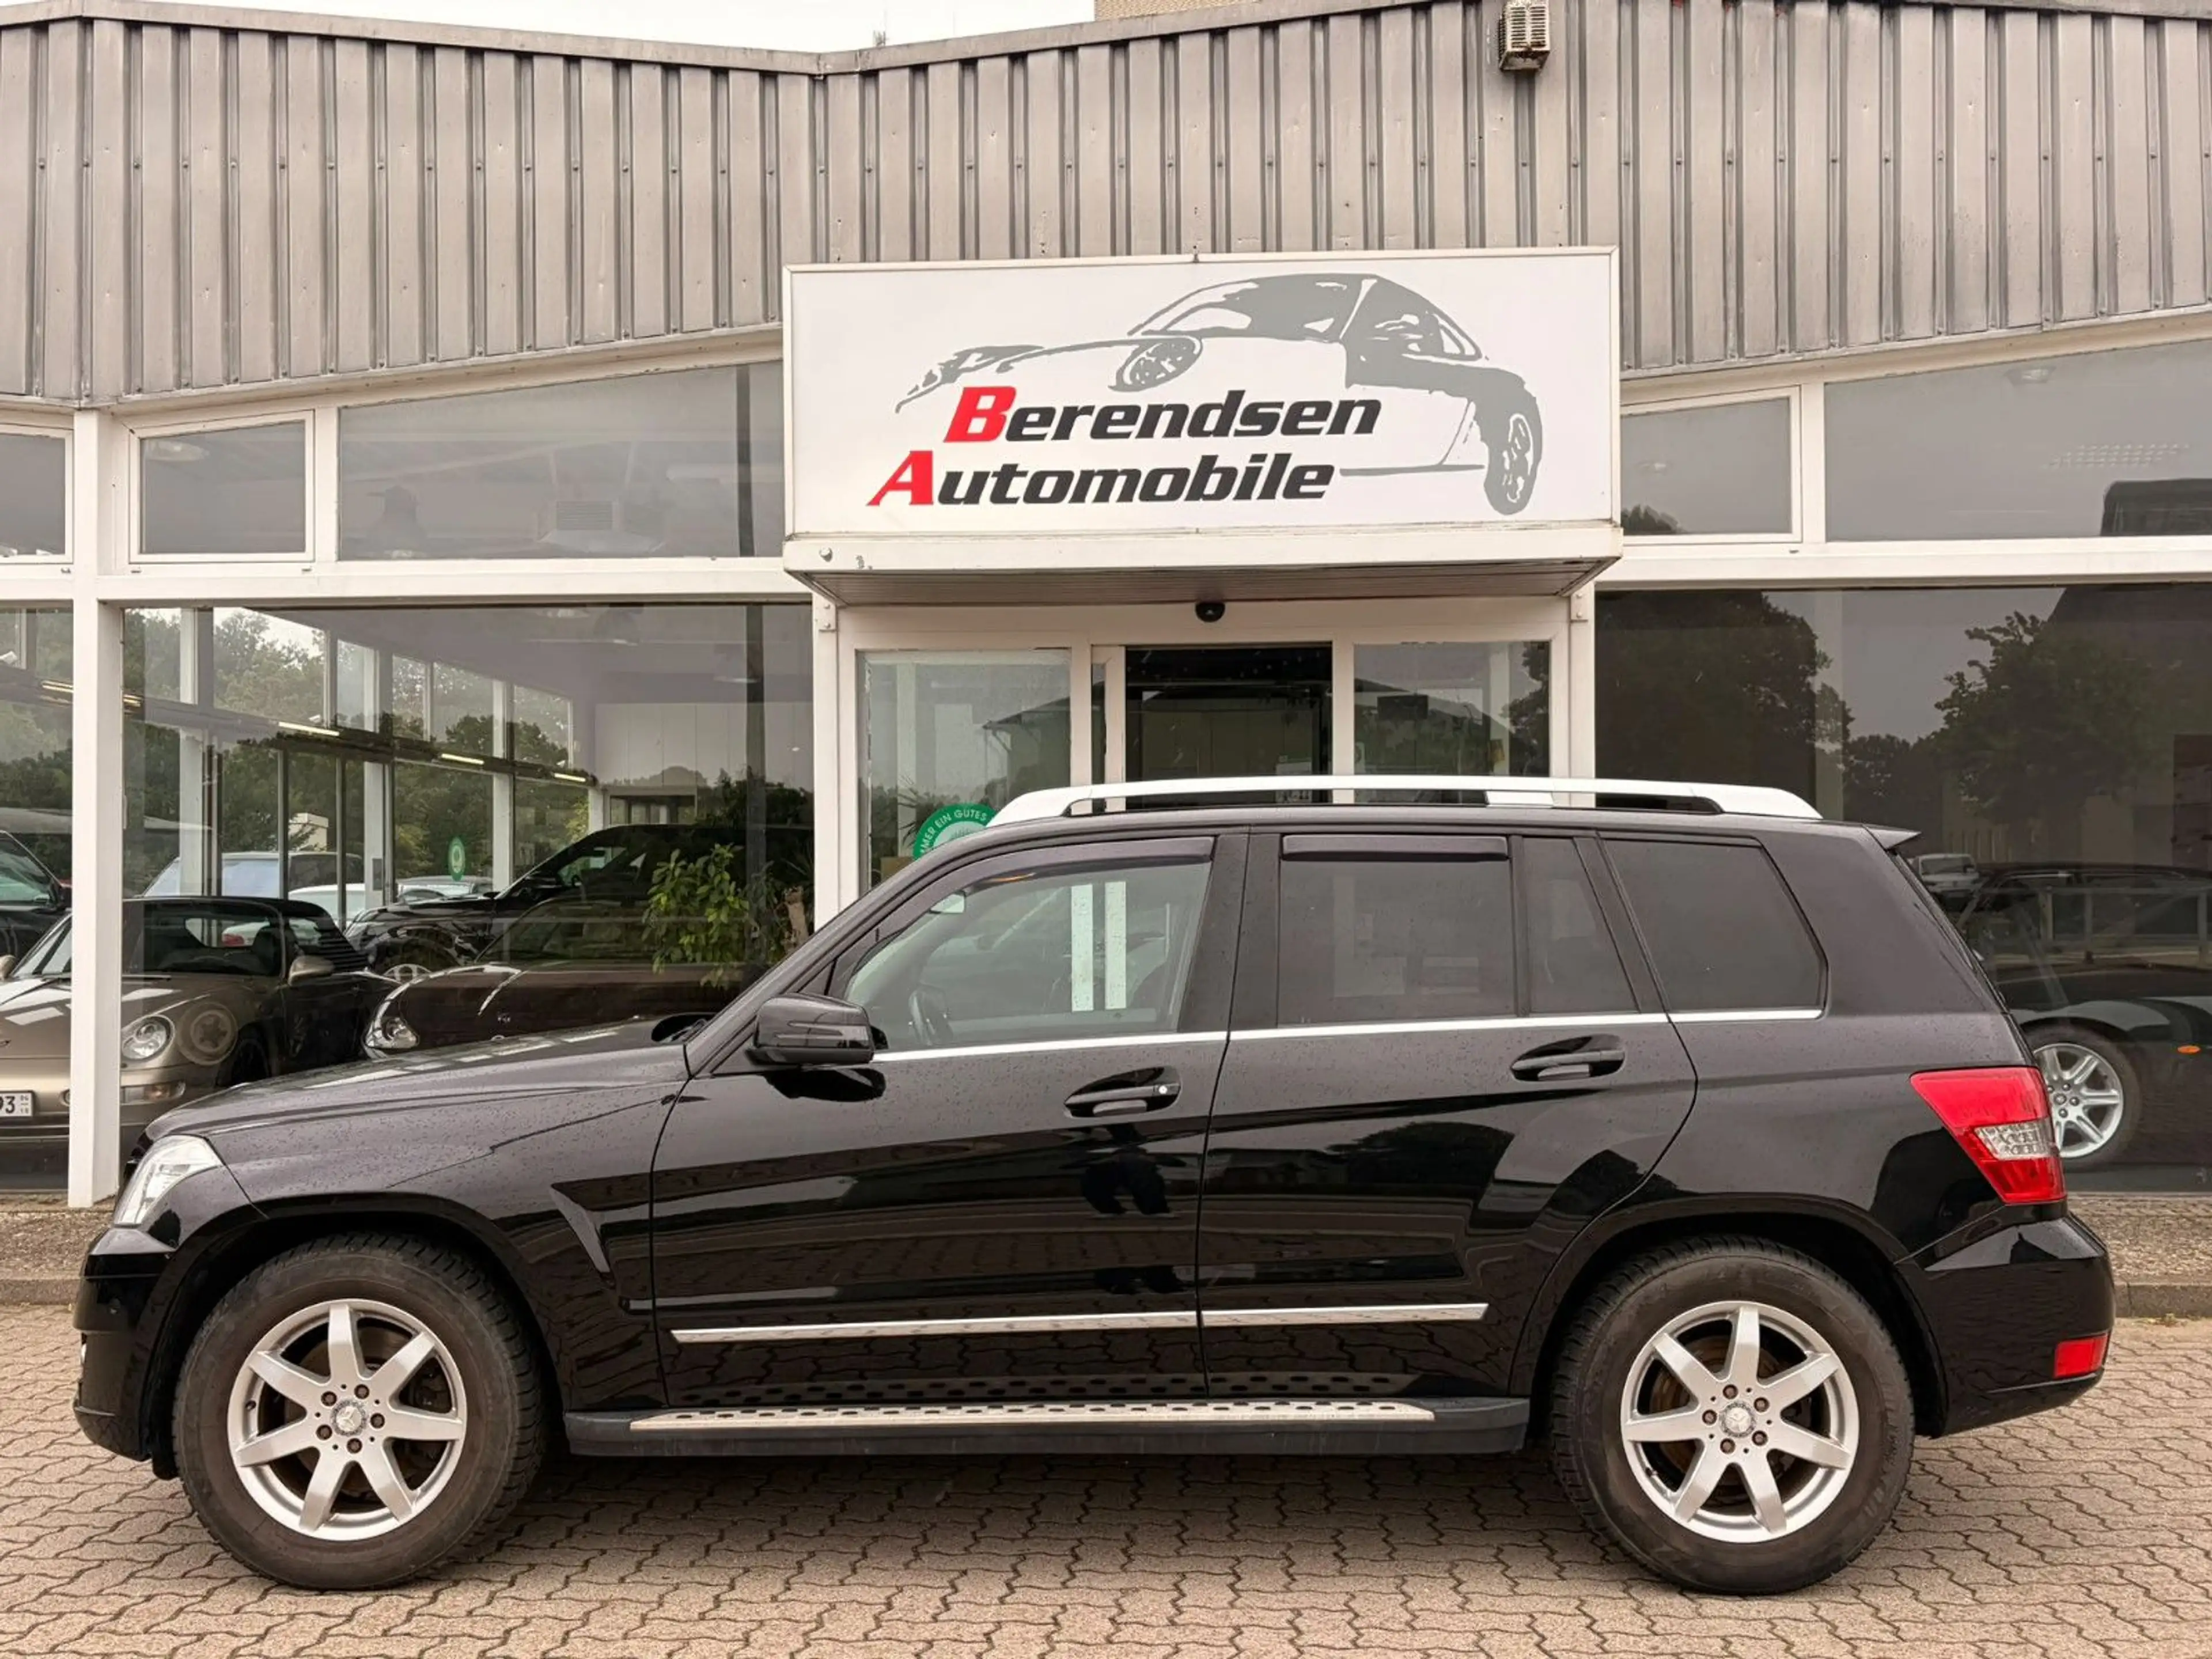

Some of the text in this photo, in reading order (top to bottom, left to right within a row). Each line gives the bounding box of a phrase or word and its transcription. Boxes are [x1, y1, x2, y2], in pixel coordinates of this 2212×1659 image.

[945, 387, 1381, 443] Berendsen
[868, 450, 1335, 506] Automobile
[920, 827, 936, 853] MER
[934, 813, 952, 828] EIN
[954, 809, 987, 821] GUTES
